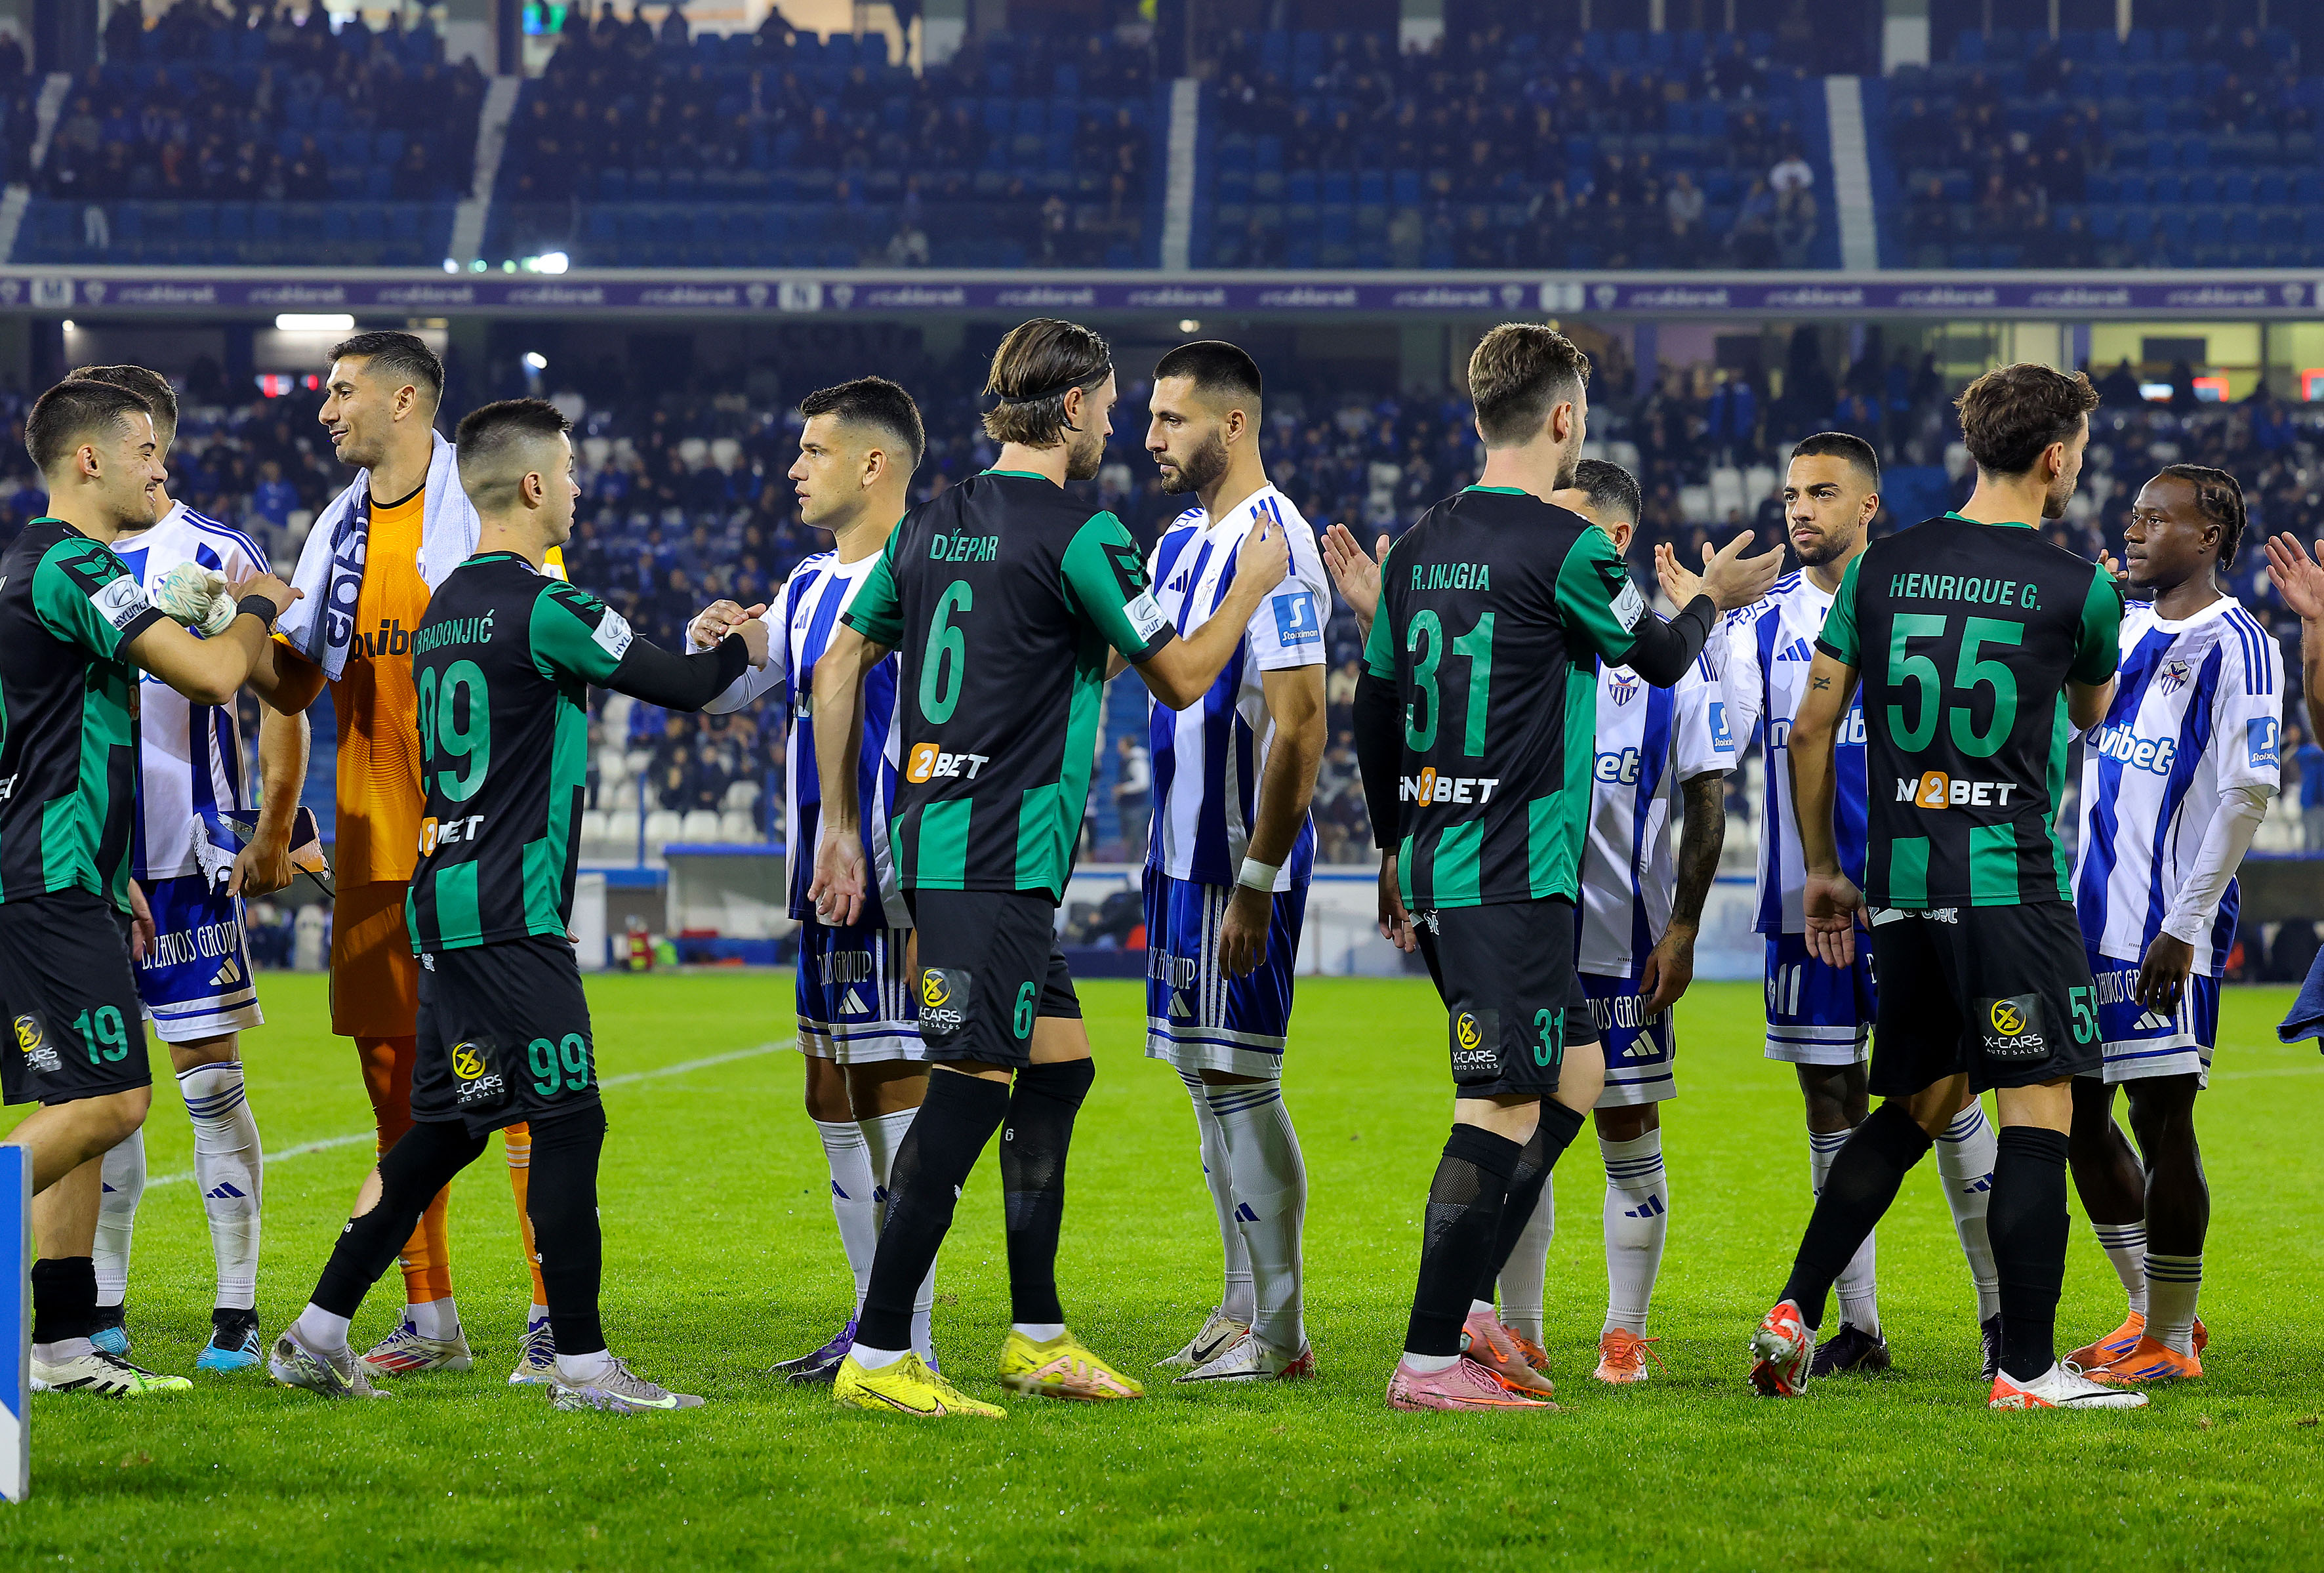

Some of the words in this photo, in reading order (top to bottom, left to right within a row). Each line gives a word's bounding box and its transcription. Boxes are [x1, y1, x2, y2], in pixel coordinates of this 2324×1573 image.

[929, 528, 999, 563] DŽEPAR
[1412, 562, 1490, 592] R.INJGIA
[1890, 573, 2017, 605] HENRIQUE
[2020, 583, 2042, 611] G.
[417, 608, 495, 656] BRADONJIĆ
[1282, 630, 1318, 642] Stoiximan
[918, 579, 973, 724] 6
[1405, 609, 1496, 758] 31
[1886, 613, 2025, 758] 55
[197, 920, 237, 958] GROUP
[834, 950, 872, 983] GROUP
[1013, 981, 1036, 1040] 6
[73, 1005, 128, 1065] 19
[1533, 1006, 1564, 1067] 31
[1983, 1033, 2043, 1049] X-CARS
[2012, 1046, 2046, 1055] SALES
[528, 1032, 588, 1095] 99
[1453, 1050, 1497, 1063] X-CARS
[1006, 1128, 1014, 1141] 6
